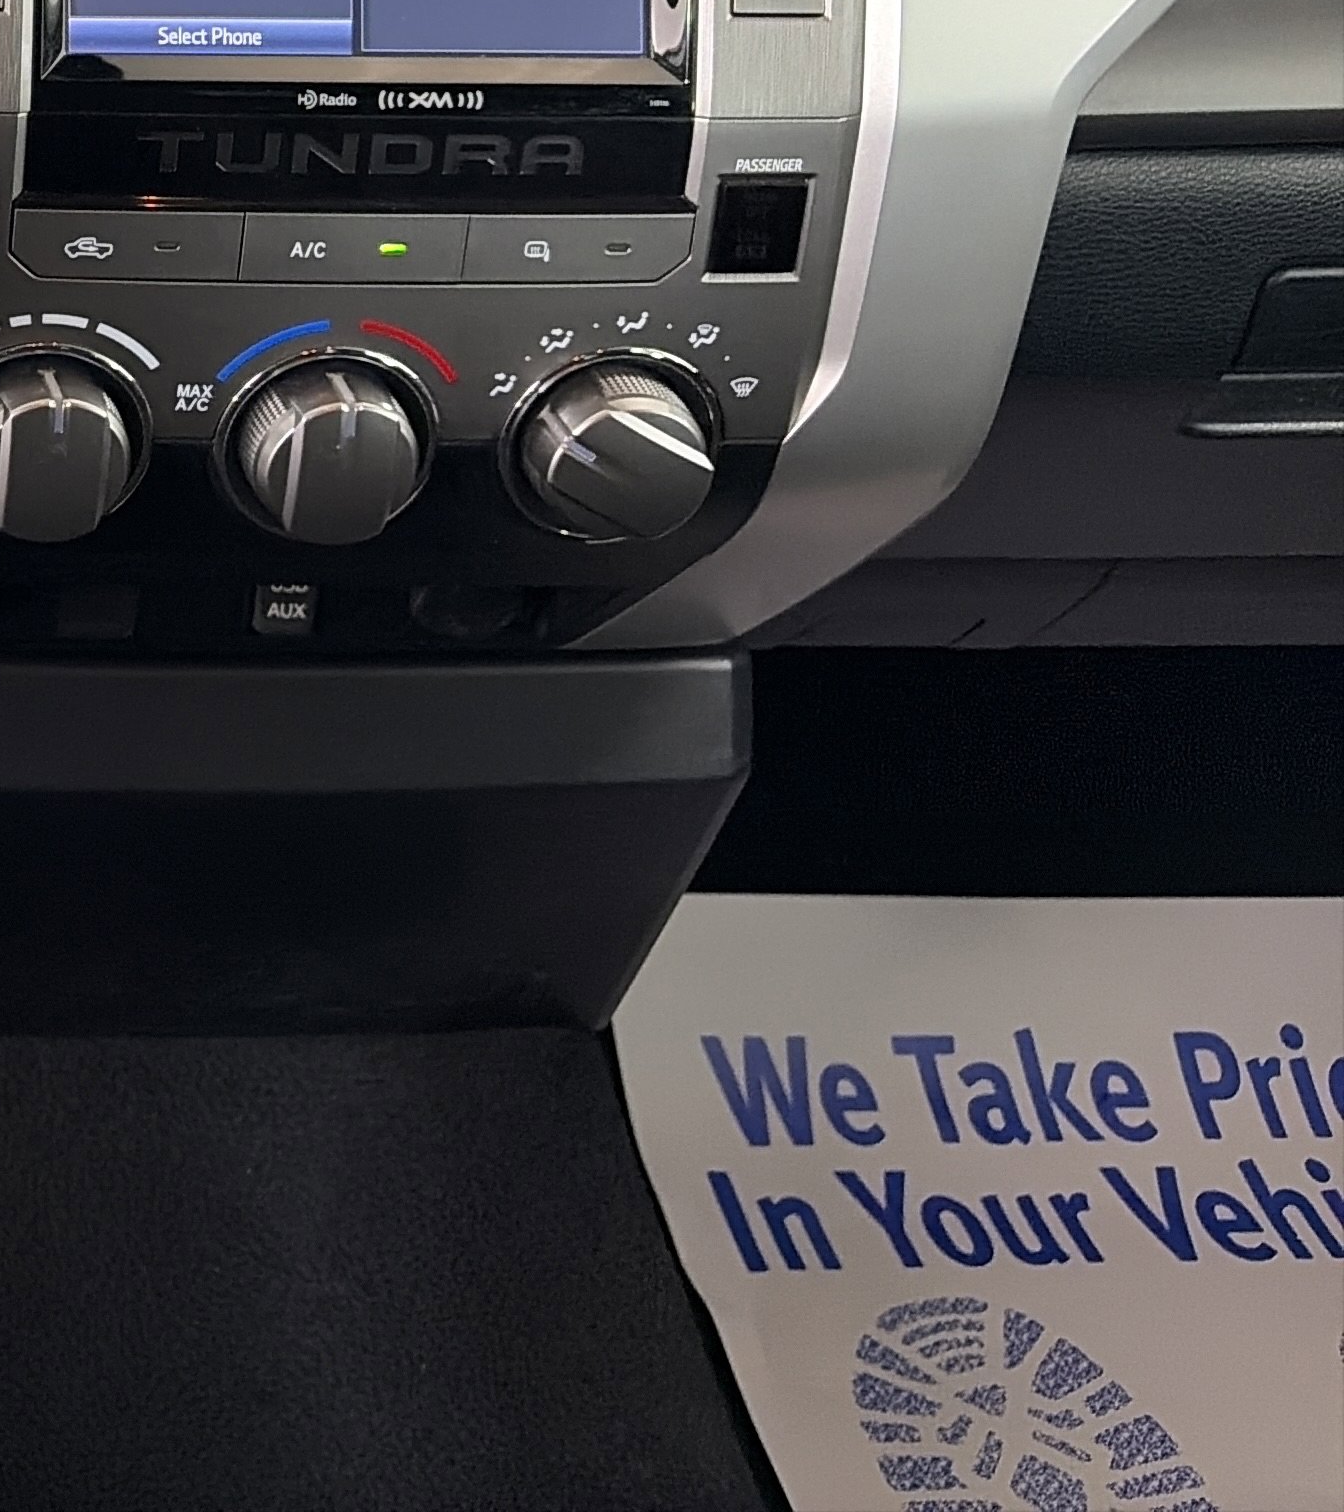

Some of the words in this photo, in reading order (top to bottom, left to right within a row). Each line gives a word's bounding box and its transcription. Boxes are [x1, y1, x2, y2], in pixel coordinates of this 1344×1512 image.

[157, 27, 208, 46] Select
[211, 27, 263, 46] Phone
[318, 93, 358, 107] Radio
[137, 131, 586, 176] TUNDRA
[735, 158, 803, 173] PASSENGER
[289, 241, 327, 259] A/C
[176, 384, 214, 399] MAX
[174, 397, 210, 412] A/C
[266, 601, 307, 620] AUX
[700, 1034, 887, 1148] We
[891, 1026, 1159, 1147] Take
[707, 1169, 843, 1273] In
[834, 1169, 1106, 1268] Your
